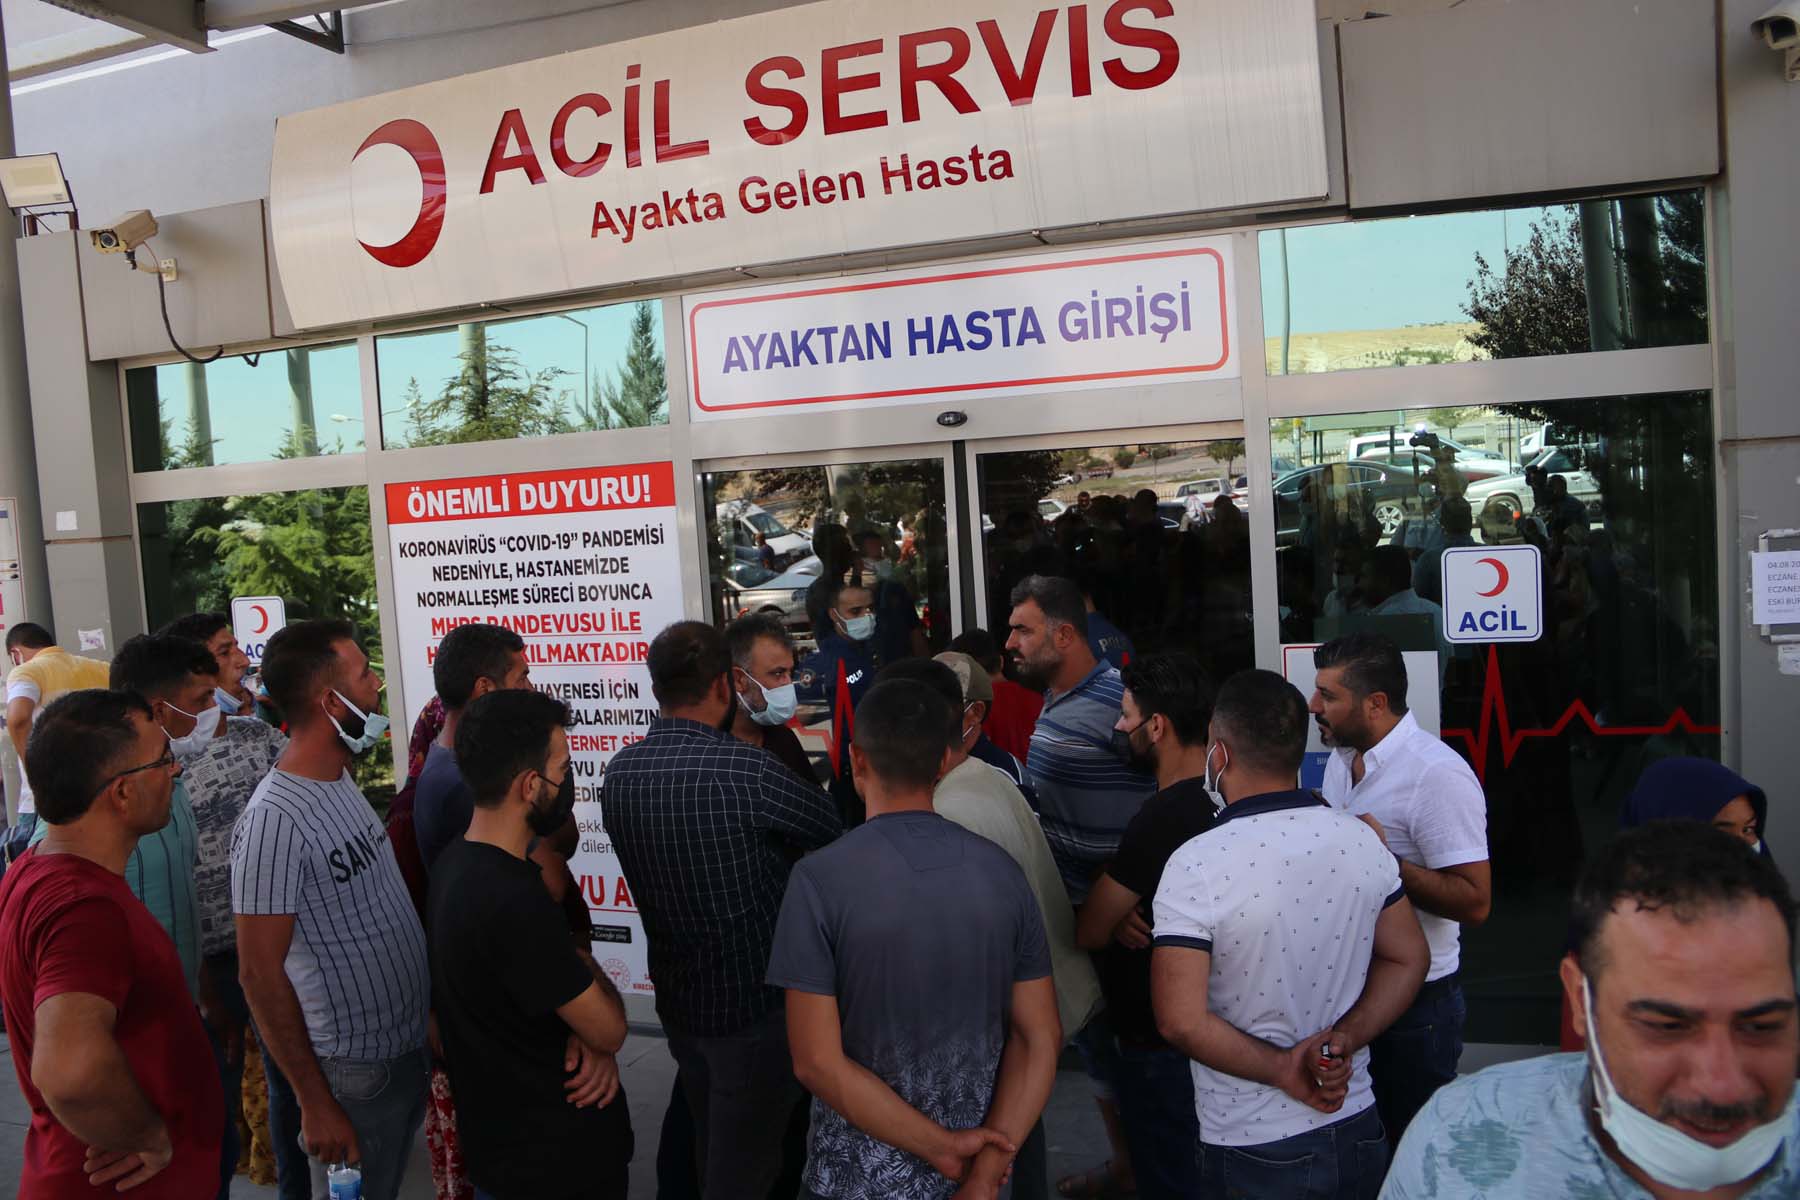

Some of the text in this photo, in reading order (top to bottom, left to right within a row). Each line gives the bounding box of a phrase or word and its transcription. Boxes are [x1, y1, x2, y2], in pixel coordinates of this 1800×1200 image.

[479, 63, 711, 195] ACİL
[590, 144, 1015, 243] Ayakta Gelen Hasta
[722, 281, 1193, 375] AYAKTAN HASTA GİRİŞİ
[407, 474, 651, 518] ÖNEMLİ DUYURU!
[399, 534, 496, 558] KORONAVİRÜS
[582, 523, 665, 549] PANDEMİSİ
[432, 556, 630, 582] NEDENİYLE, HASTANEMİZDE
[417, 582, 653, 608] NORMALLEŞME SÜRECİ BOYUNCA
[610, 607, 642, 632] İLE
[1458, 604, 1528, 633] ACİL
[245, 643, 266, 659] AC
[608, 678, 640, 702] İÇİN
